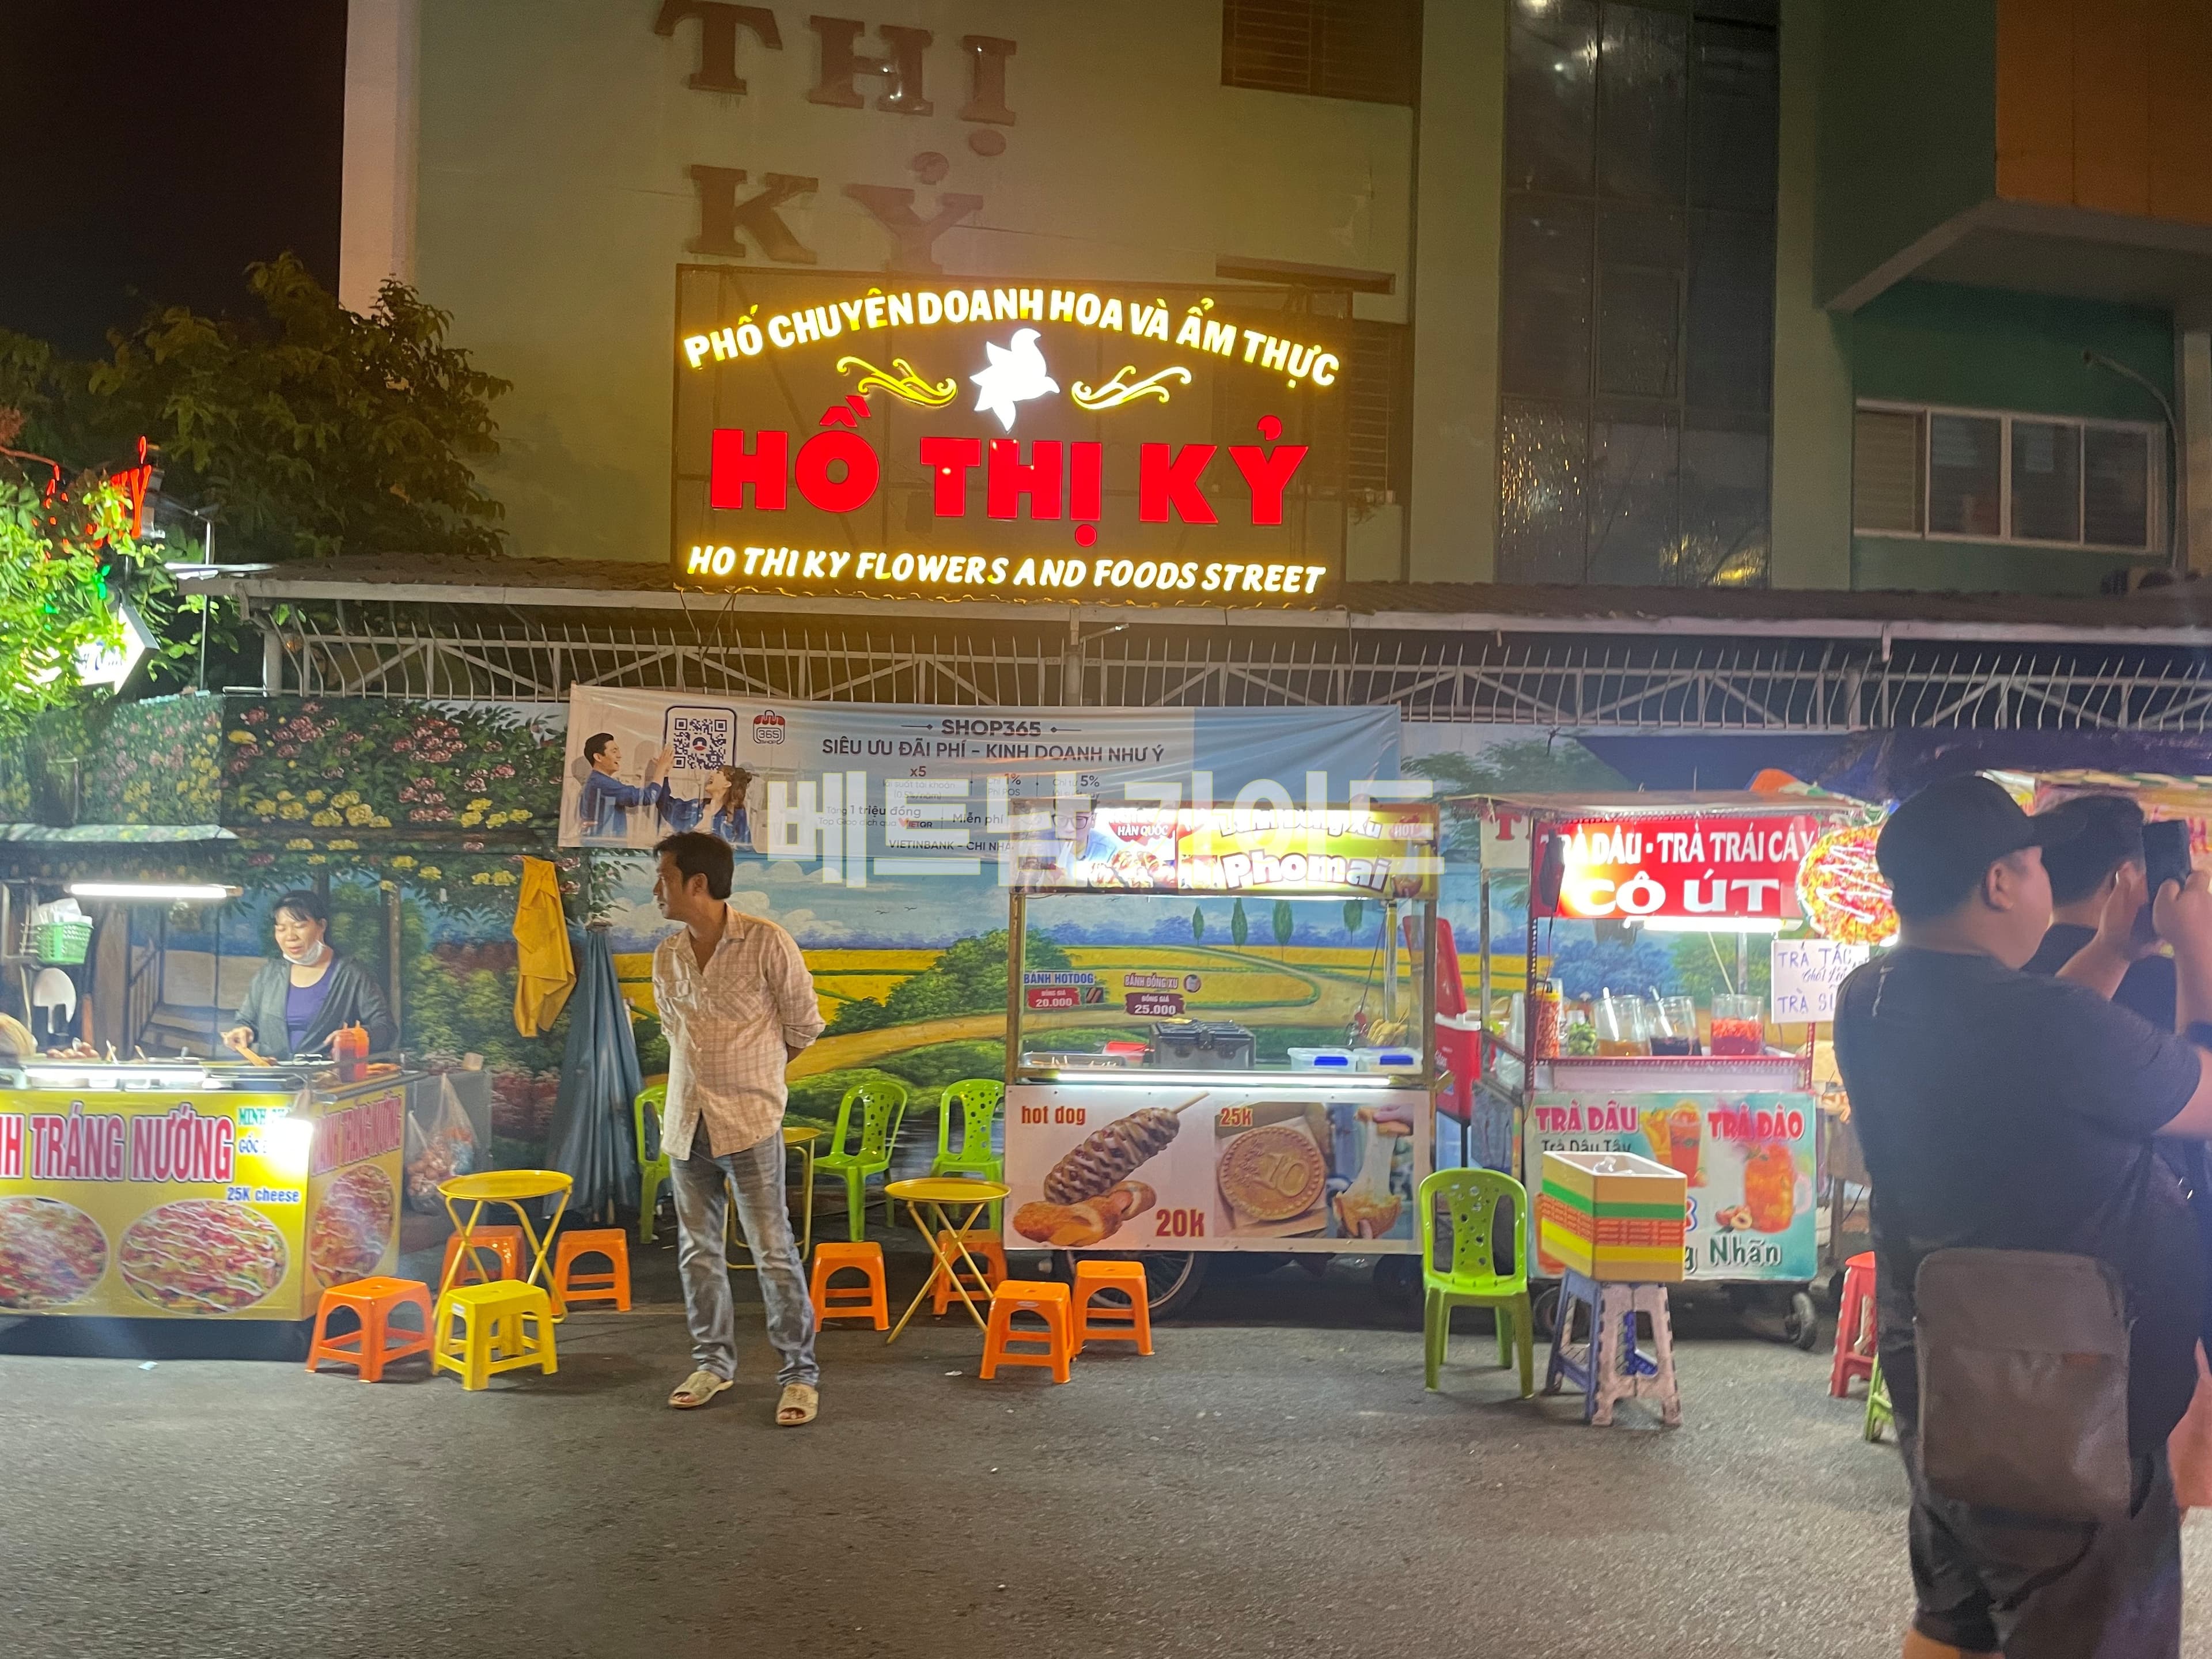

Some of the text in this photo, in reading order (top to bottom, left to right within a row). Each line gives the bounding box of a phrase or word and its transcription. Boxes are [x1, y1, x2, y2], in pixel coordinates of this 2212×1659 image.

[684, 288, 1339, 388] PHỐ CHUYÊN DOANH HOA VÀ ẨM THỰC
[711, 395, 1309, 547] HỒ THỊ KỶ
[687, 546, 1326, 594] HO THI KY FLOWERS AND FOODS STREET
[759, 730, 779, 738] 365
[941, 719, 1041, 737] SHOP365
[823, 736, 862, 755] SIÊU
[868, 739, 892, 756] ƯU
[899, 738, 930, 757] ĐÃI
[937, 740, 965, 758] PHÍ
[986, 744, 1029, 759] KINH
[1035, 745, 1103, 762] DOANH
[1109, 747, 1148, 763] NHƯ
[1152, 744, 1164, 762] Ý
[910, 766, 926, 778] x5
[1005, 774, 1021, 785] 1%
[1081, 775, 1100, 787] 5%
[859, 806, 886, 817] triệu
[889, 840, 954, 850] VIETINBANK
[967, 842, 985, 851] CHI
[1657, 821, 1705, 863] TRÀ
[1709, 821, 1764, 862] TRÁI
[1222, 849, 1393, 892] Phomai
[1570, 868, 1779, 915] CÔ ÚT
[1024, 971, 1094, 984] BÁNH HOTDOG
[1035, 998, 1073, 1007] 20.000
[1134, 1004, 1176, 1014] 25.000
[1022, 1106, 1086, 1126] hot dog
[29, 1100, 126, 1181] TRÁNG
[130, 1103, 235, 1183] NƯỚNG
[227, 1187, 299, 1202] 25K cheese
[1710, 1236, 1782, 1267] Nhãn
